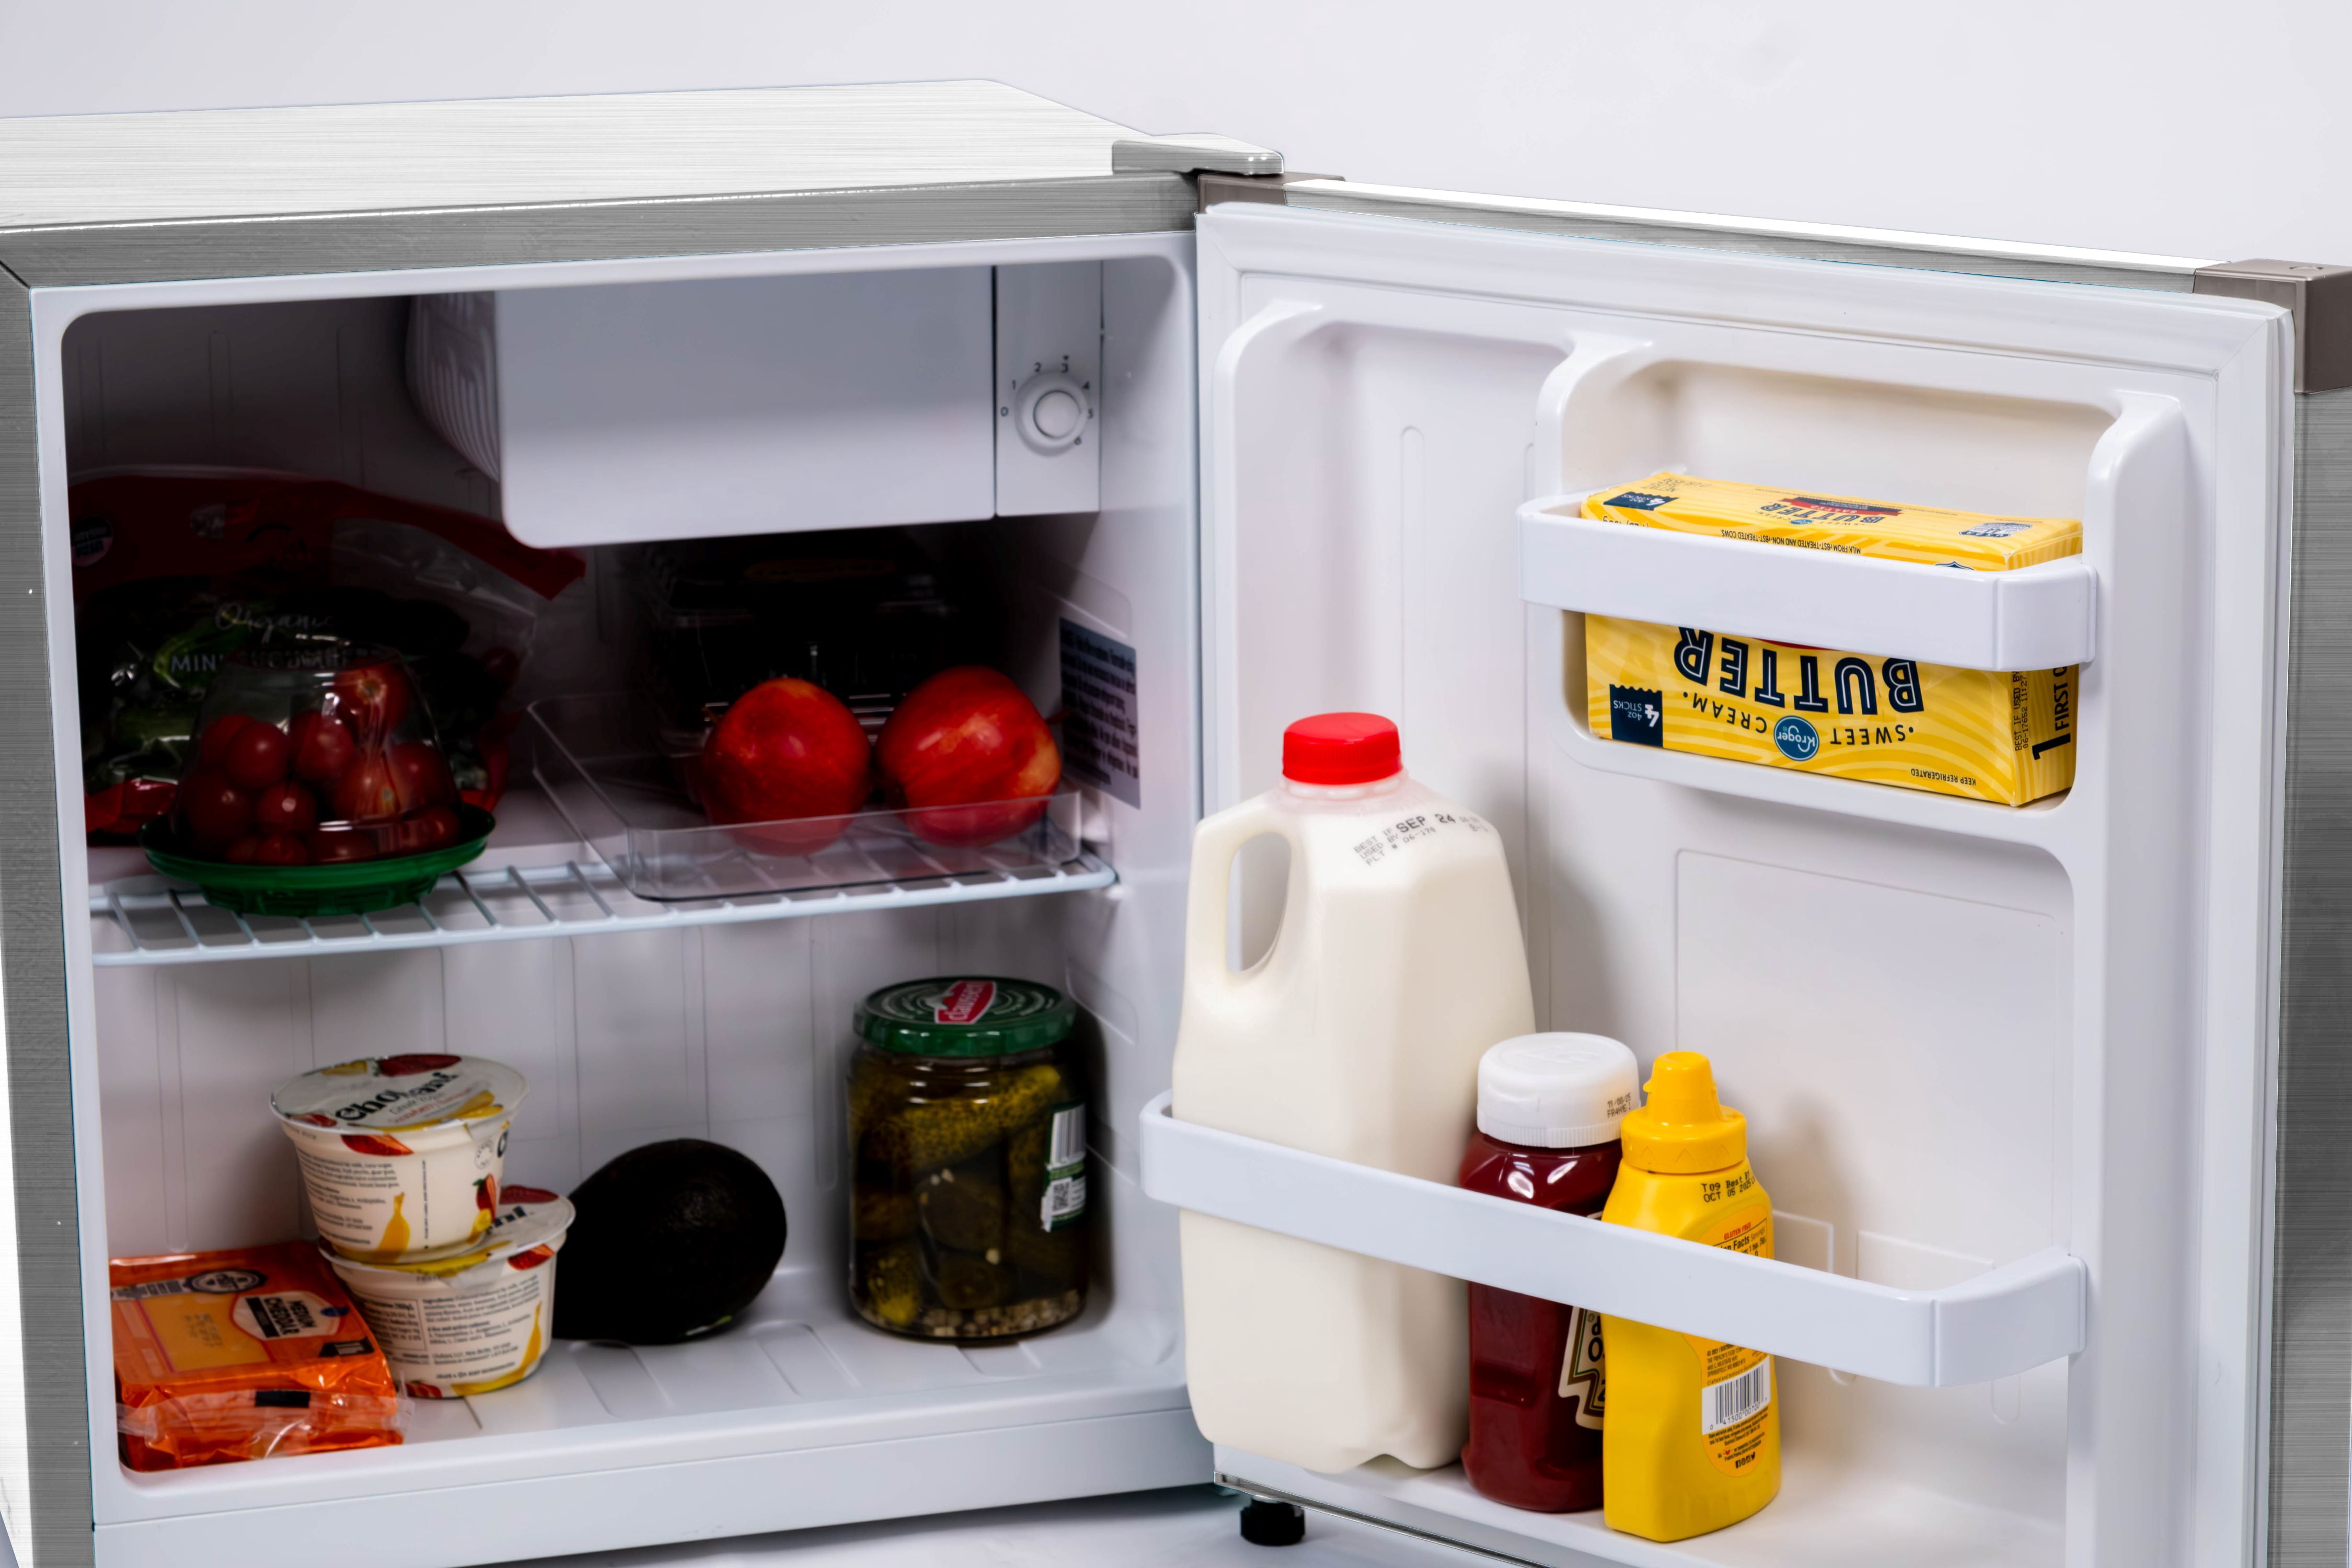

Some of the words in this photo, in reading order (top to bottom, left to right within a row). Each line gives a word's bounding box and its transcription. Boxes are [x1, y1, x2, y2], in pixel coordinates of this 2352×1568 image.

[1000, 407, 1008, 417] 0
[1760, 503, 1885, 524] BUTTER
[1720, 529, 1737, 539] COWS.
[1737, 532, 1785, 545] NON-rBST-TREATED
[1785, 538, 1796, 546] AND
[1797, 539, 1832, 550] rBST-TREATED
[1834, 544, 1848, 552] FROM
[1849, 545, 1861, 554] MILK
[1673, 627, 1926, 715] BUTTER
[2012, 672, 2020, 682] BY
[1613, 699, 1643, 712] STICKS
[2053, 683, 2070, 732] FIRST
[1628, 711, 1643, 721] 4oz
[1644, 704, 1660, 728] 4
[1691, 693, 1768, 734] CREAM
[2014, 716, 2021, 725] IF
[1777, 724, 1816, 752] Kroger
[1830, 724, 1906, 746] SWEET
[2014, 731, 2022, 751] BEST
[1910, 768, 1958, 782] REFRIGERATED
[1960, 777, 1976, 786] KEEP
[1353, 835, 1379, 854] BEST
[1396, 815, 1426, 833] SEP
[1434, 813, 1456, 824] 24
[1359, 842, 1384, 860] USED
[1701, 1182, 1721, 1192] T09
[1726, 1176, 1743, 1189] Best
[1703, 1191, 1721, 1203] OCT
[1727, 1187, 1736, 1197] 05
[1739, 1179, 1751, 1193] 2025
[1724, 1227, 1741, 1240] GLUTEN
[1733, 1236, 1750, 1251] Facts
[263, 1296, 300, 1336] CHEDDAR
[1723, 1412, 1743, 1425] 41500
